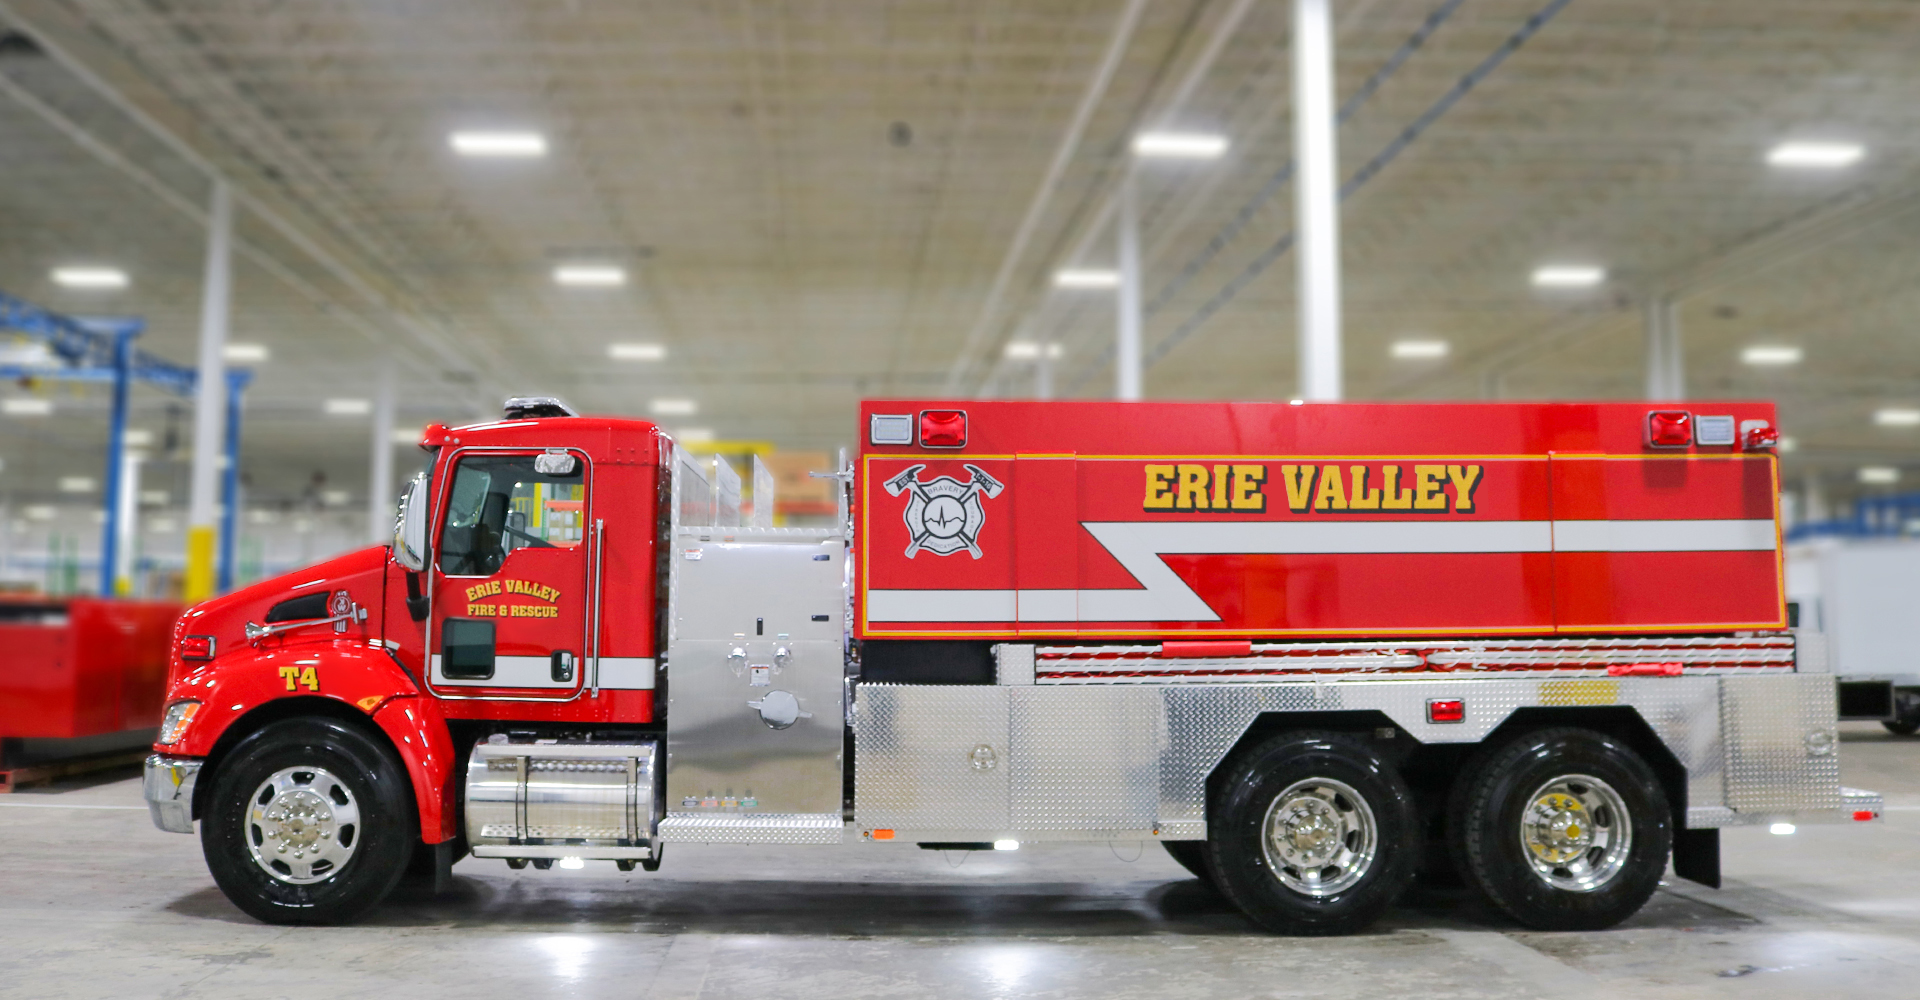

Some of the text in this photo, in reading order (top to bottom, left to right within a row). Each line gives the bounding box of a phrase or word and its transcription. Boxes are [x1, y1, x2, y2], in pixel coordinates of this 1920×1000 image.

[927, 484, 964, 495] BRAVERY
[1142, 464, 1484, 514] ERIE VALLEY
[465, 580, 561, 604] ERIE VALLEY
[467, 604, 559, 618] FIRE & RESCUE
[279, 666, 320, 692] T4
